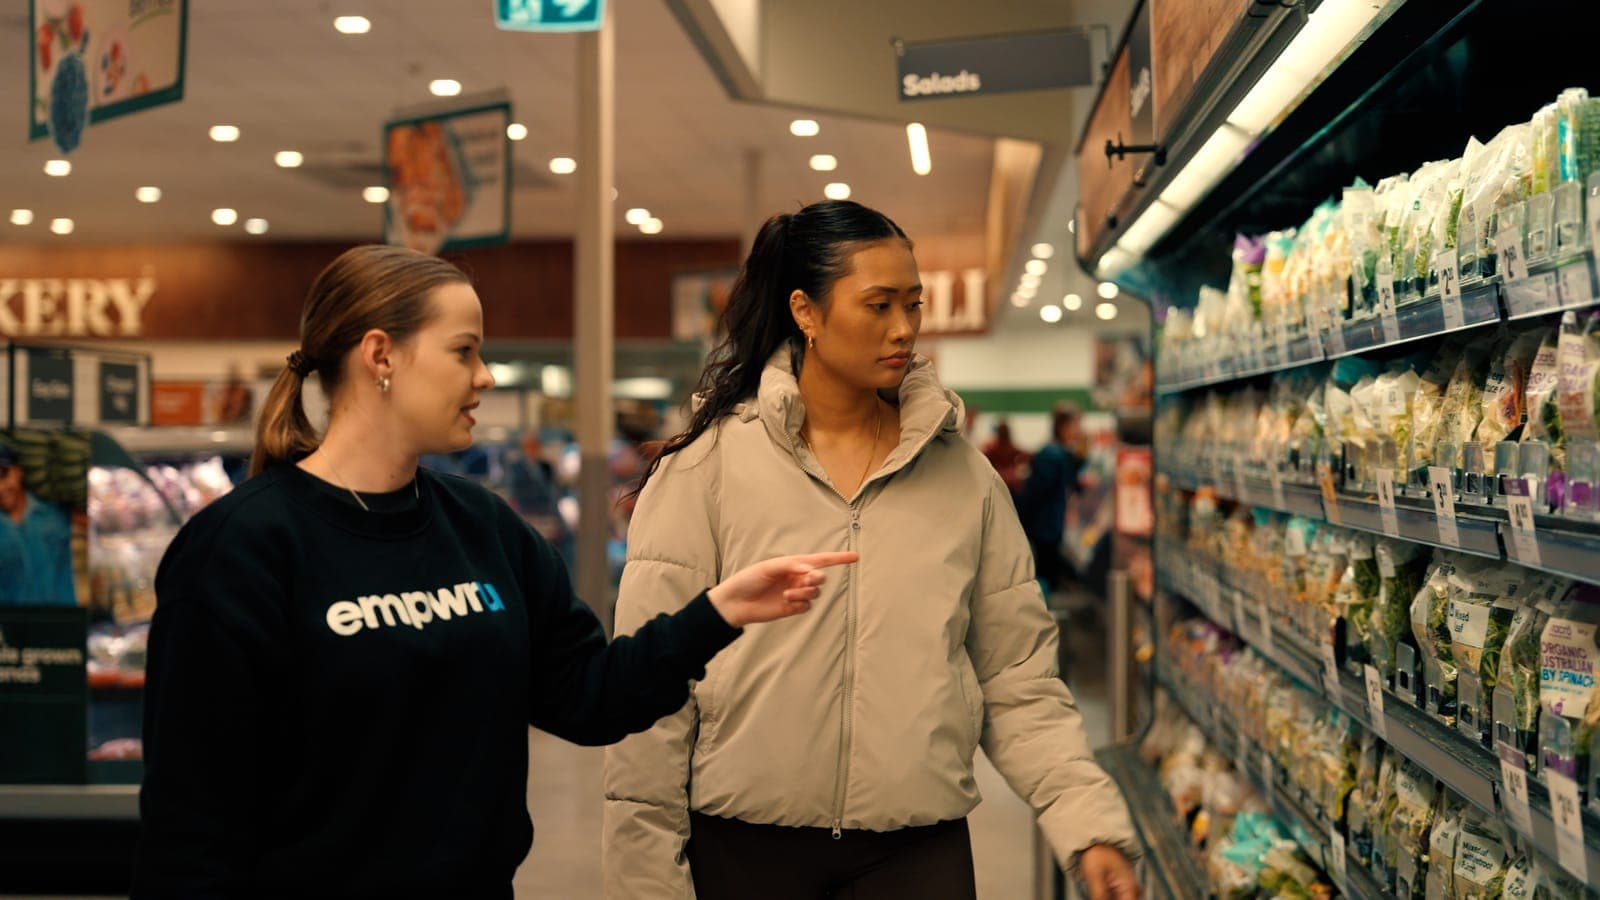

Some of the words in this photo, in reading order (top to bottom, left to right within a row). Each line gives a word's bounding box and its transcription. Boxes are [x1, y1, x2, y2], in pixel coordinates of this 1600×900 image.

[902, 70, 981, 97] Salads
[326, 581, 506, 636] empwru
[21, 647, 82, 668] grown
[1541, 655, 1594, 674] USTRALIAN
[1541, 668, 1556, 682] BY
